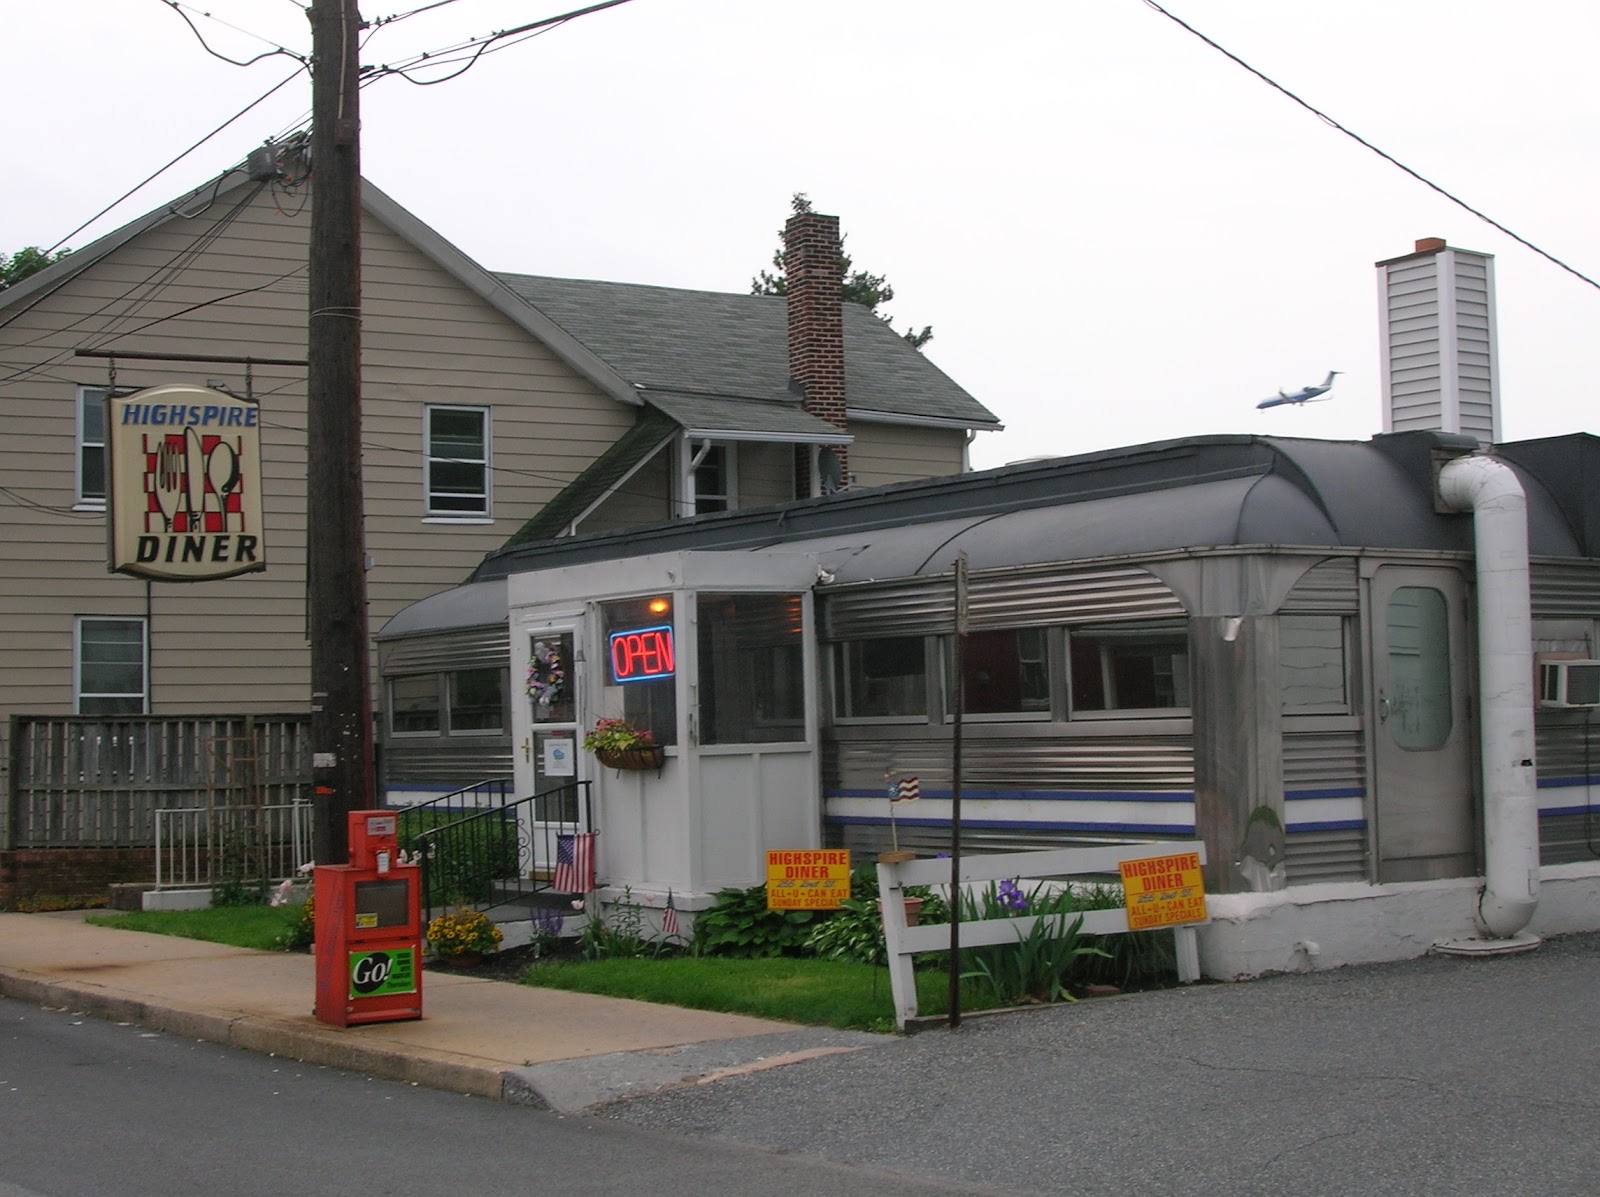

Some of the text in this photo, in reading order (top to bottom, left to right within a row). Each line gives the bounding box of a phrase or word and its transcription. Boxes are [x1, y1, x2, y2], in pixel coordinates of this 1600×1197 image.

[122, 404, 258, 427] HIGHSPIRE
[136, 535, 257, 562] DINER
[613, 632, 674, 676] OPEN
[769, 852, 847, 865] HIGHSPIRE
[1123, 856, 1198, 878] HIGHSPIRE
[785, 866, 829, 878] DINER
[1142, 873, 1184, 892] DINER
[772, 899, 801, 907] SUNDAY
[831, 889, 848, 898] EAT
[1187, 897, 1203, 908] EAT
[1134, 907, 1202, 927] SUNDAY SPECIALS
[352, 957, 393, 985] Go!
